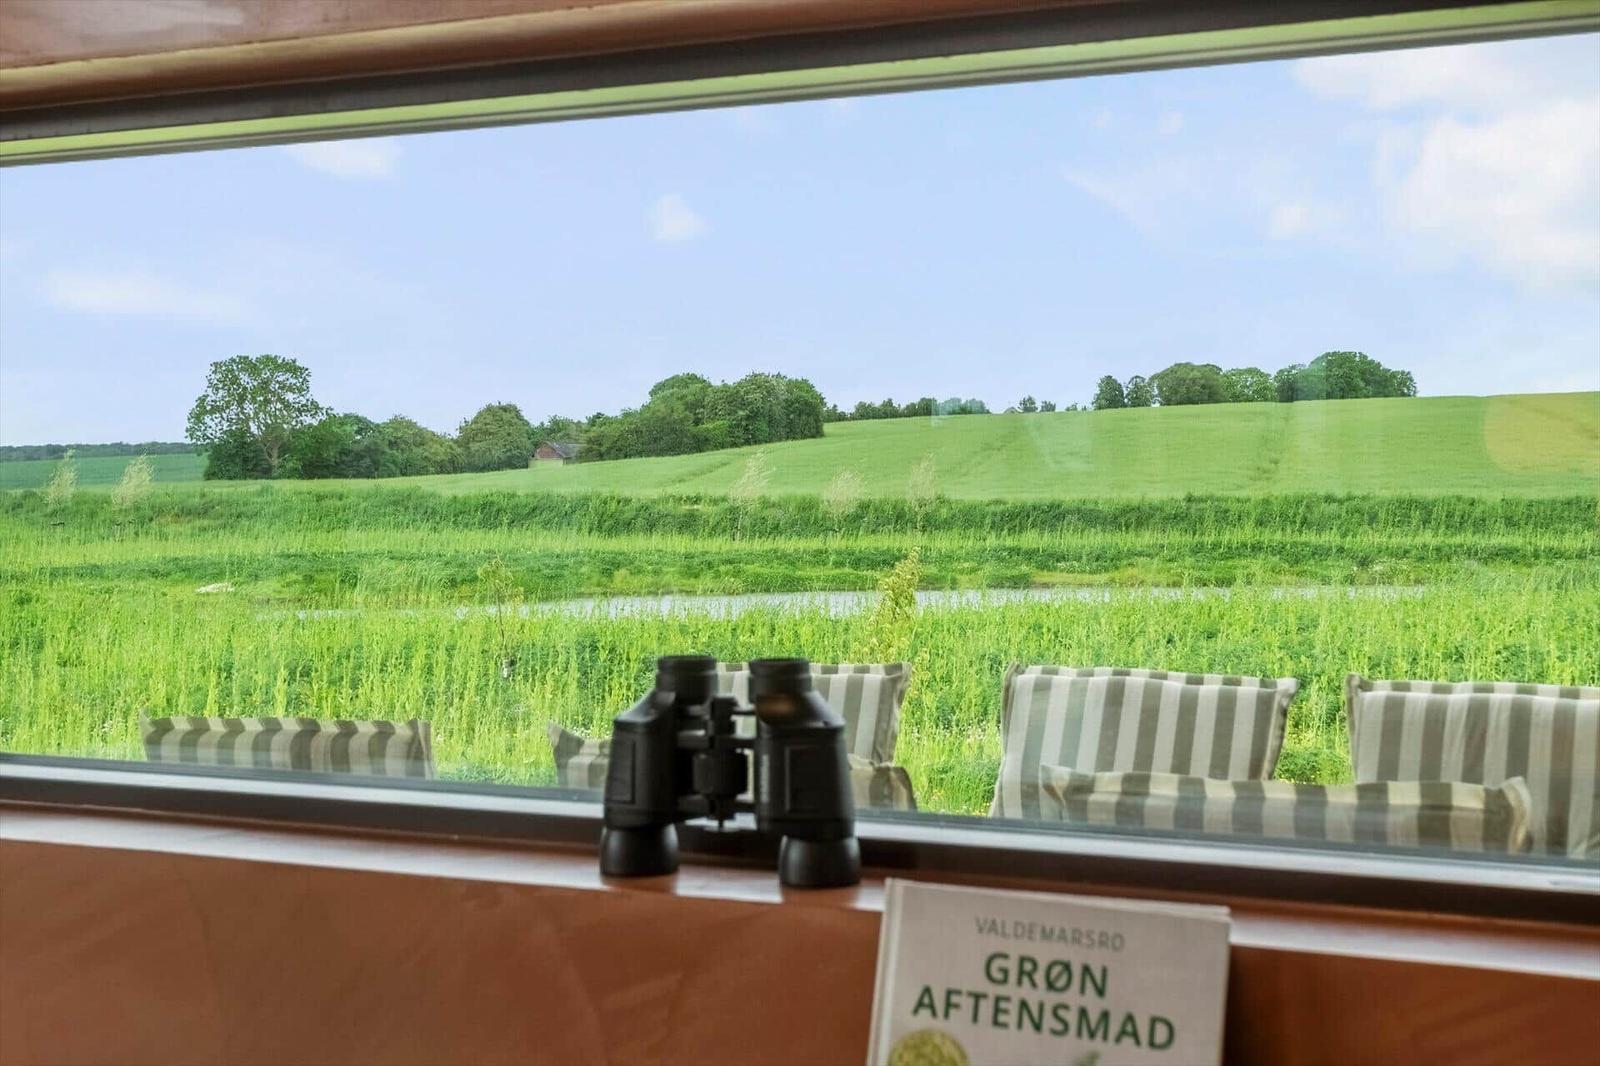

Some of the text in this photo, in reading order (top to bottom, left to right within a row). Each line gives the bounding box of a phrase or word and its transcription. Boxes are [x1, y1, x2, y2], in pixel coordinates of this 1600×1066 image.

[976, 917, 1125, 951] VALDEMARSRO
[985, 952, 1108, 998] GRØN
[912, 985, 1175, 1050] AFTENSMAD
